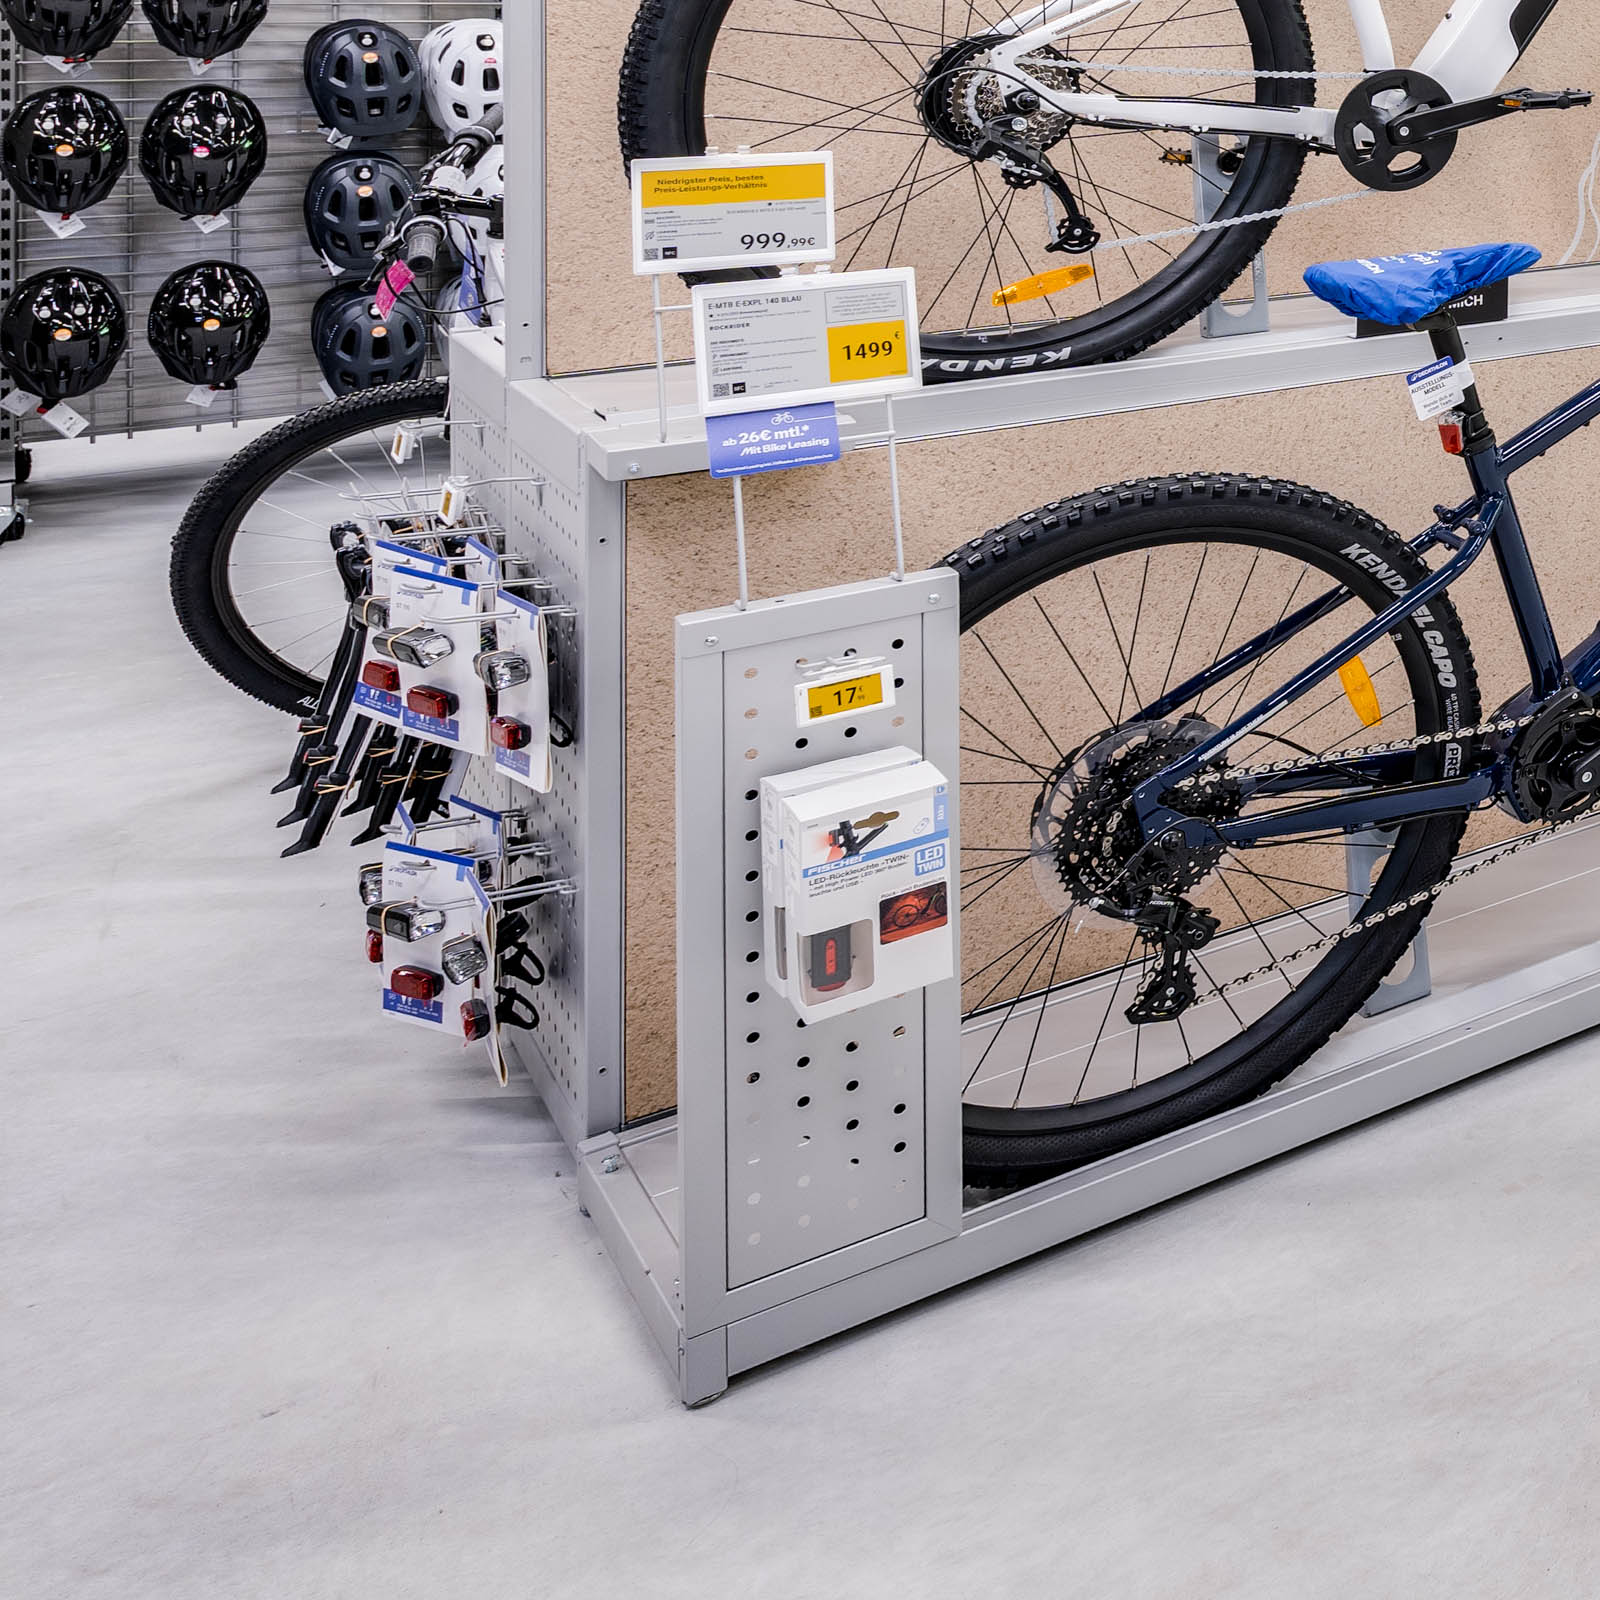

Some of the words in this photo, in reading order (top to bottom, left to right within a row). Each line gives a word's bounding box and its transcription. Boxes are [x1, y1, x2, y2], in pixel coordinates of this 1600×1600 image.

[653, 182, 768, 194] Preis-Leistungs-Verhältnis
[657, 176, 707, 186] Niedrigster
[708, 175, 734, 184] Preis,
[735, 174, 764, 182] bestes
[740, 232, 816, 250] 999,99€
[1448, 294, 1484, 310] MICH
[709, 321, 750, 331] ROCKRIDER
[842, 340, 893, 361] 1499
[1411, 371, 1455, 395] AUSSTELLUNGS-
[1424, 382, 1446, 396] MODELL
[722, 438, 737, 447] ab
[738, 429, 772, 444] 26€
[740, 446, 762, 456] Mit
[763, 442, 787, 453] Bike
[788, 438, 830, 450] Leasing
[1422, 629, 1457, 689] CAPO
[833, 687, 857, 706] 17
[917, 845, 944, 862] LED
[809, 862, 880, 887] LED-Rückleuchte
[917, 859, 944, 875] TWIN
